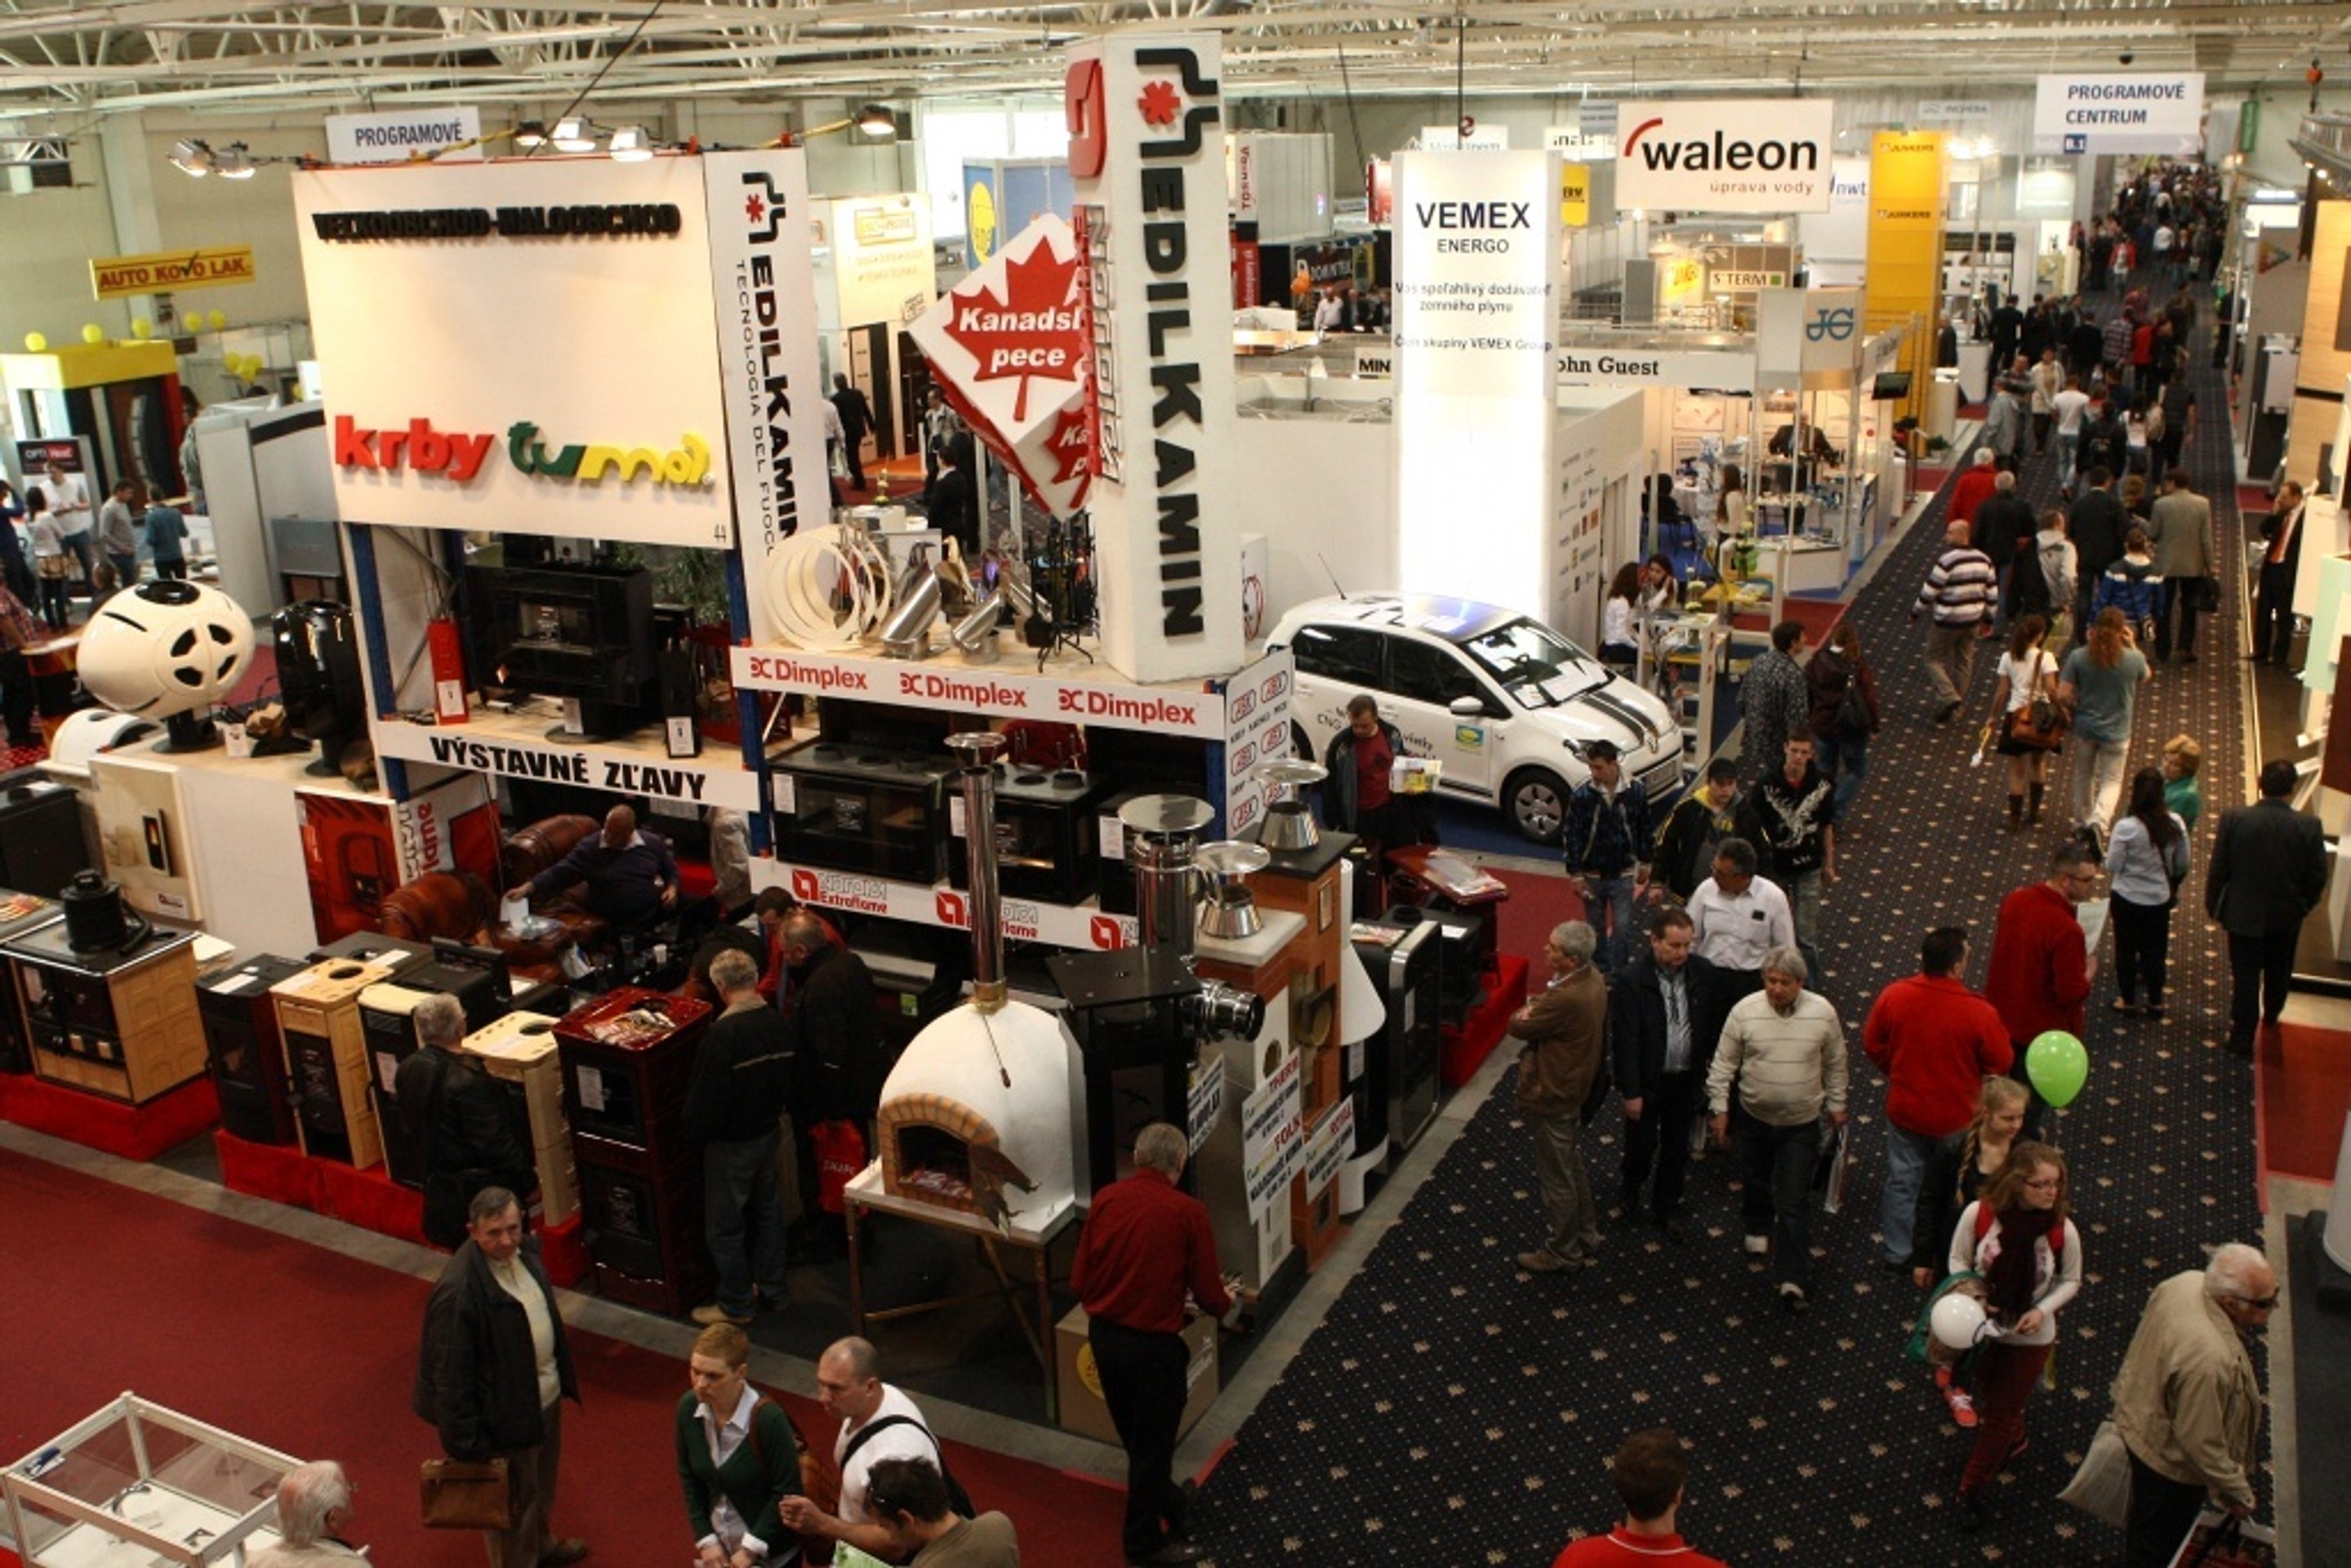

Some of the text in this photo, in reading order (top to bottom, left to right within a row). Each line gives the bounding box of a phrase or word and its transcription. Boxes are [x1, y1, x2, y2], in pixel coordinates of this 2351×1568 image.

[2067, 82, 2185, 100] PROGRAMOVÉ
[2065, 109, 2148, 123] CENTRUM
[354, 118, 463, 147] PROGRAMOVÉ
[1641, 131, 1818, 171] waleon
[1774, 180, 1815, 195] vody
[1416, 203, 1531, 229] VEMEX
[1437, 238, 1509, 253] ENERGO
[99, 268, 150, 288] AUTO
[211, 257, 245, 274] LAK
[958, 305, 1082, 332] Kanads
[1469, 337, 1512, 349] VEMEX
[989, 344, 1067, 372] pece
[1557, 357, 1659, 376] ohn Guest
[736, 260, 775, 557] TECNOLOGIA DEL FUOC
[1140, 167, 1204, 637] EDILKAMIN
[335, 415, 495, 480] krby
[775, 658, 1196, 725] Dimplex Dimplex Dimplex
[429, 737, 707, 800] VÝSTAVNÉ ZĽAVY
[822, 891, 887, 914] Extraflame
